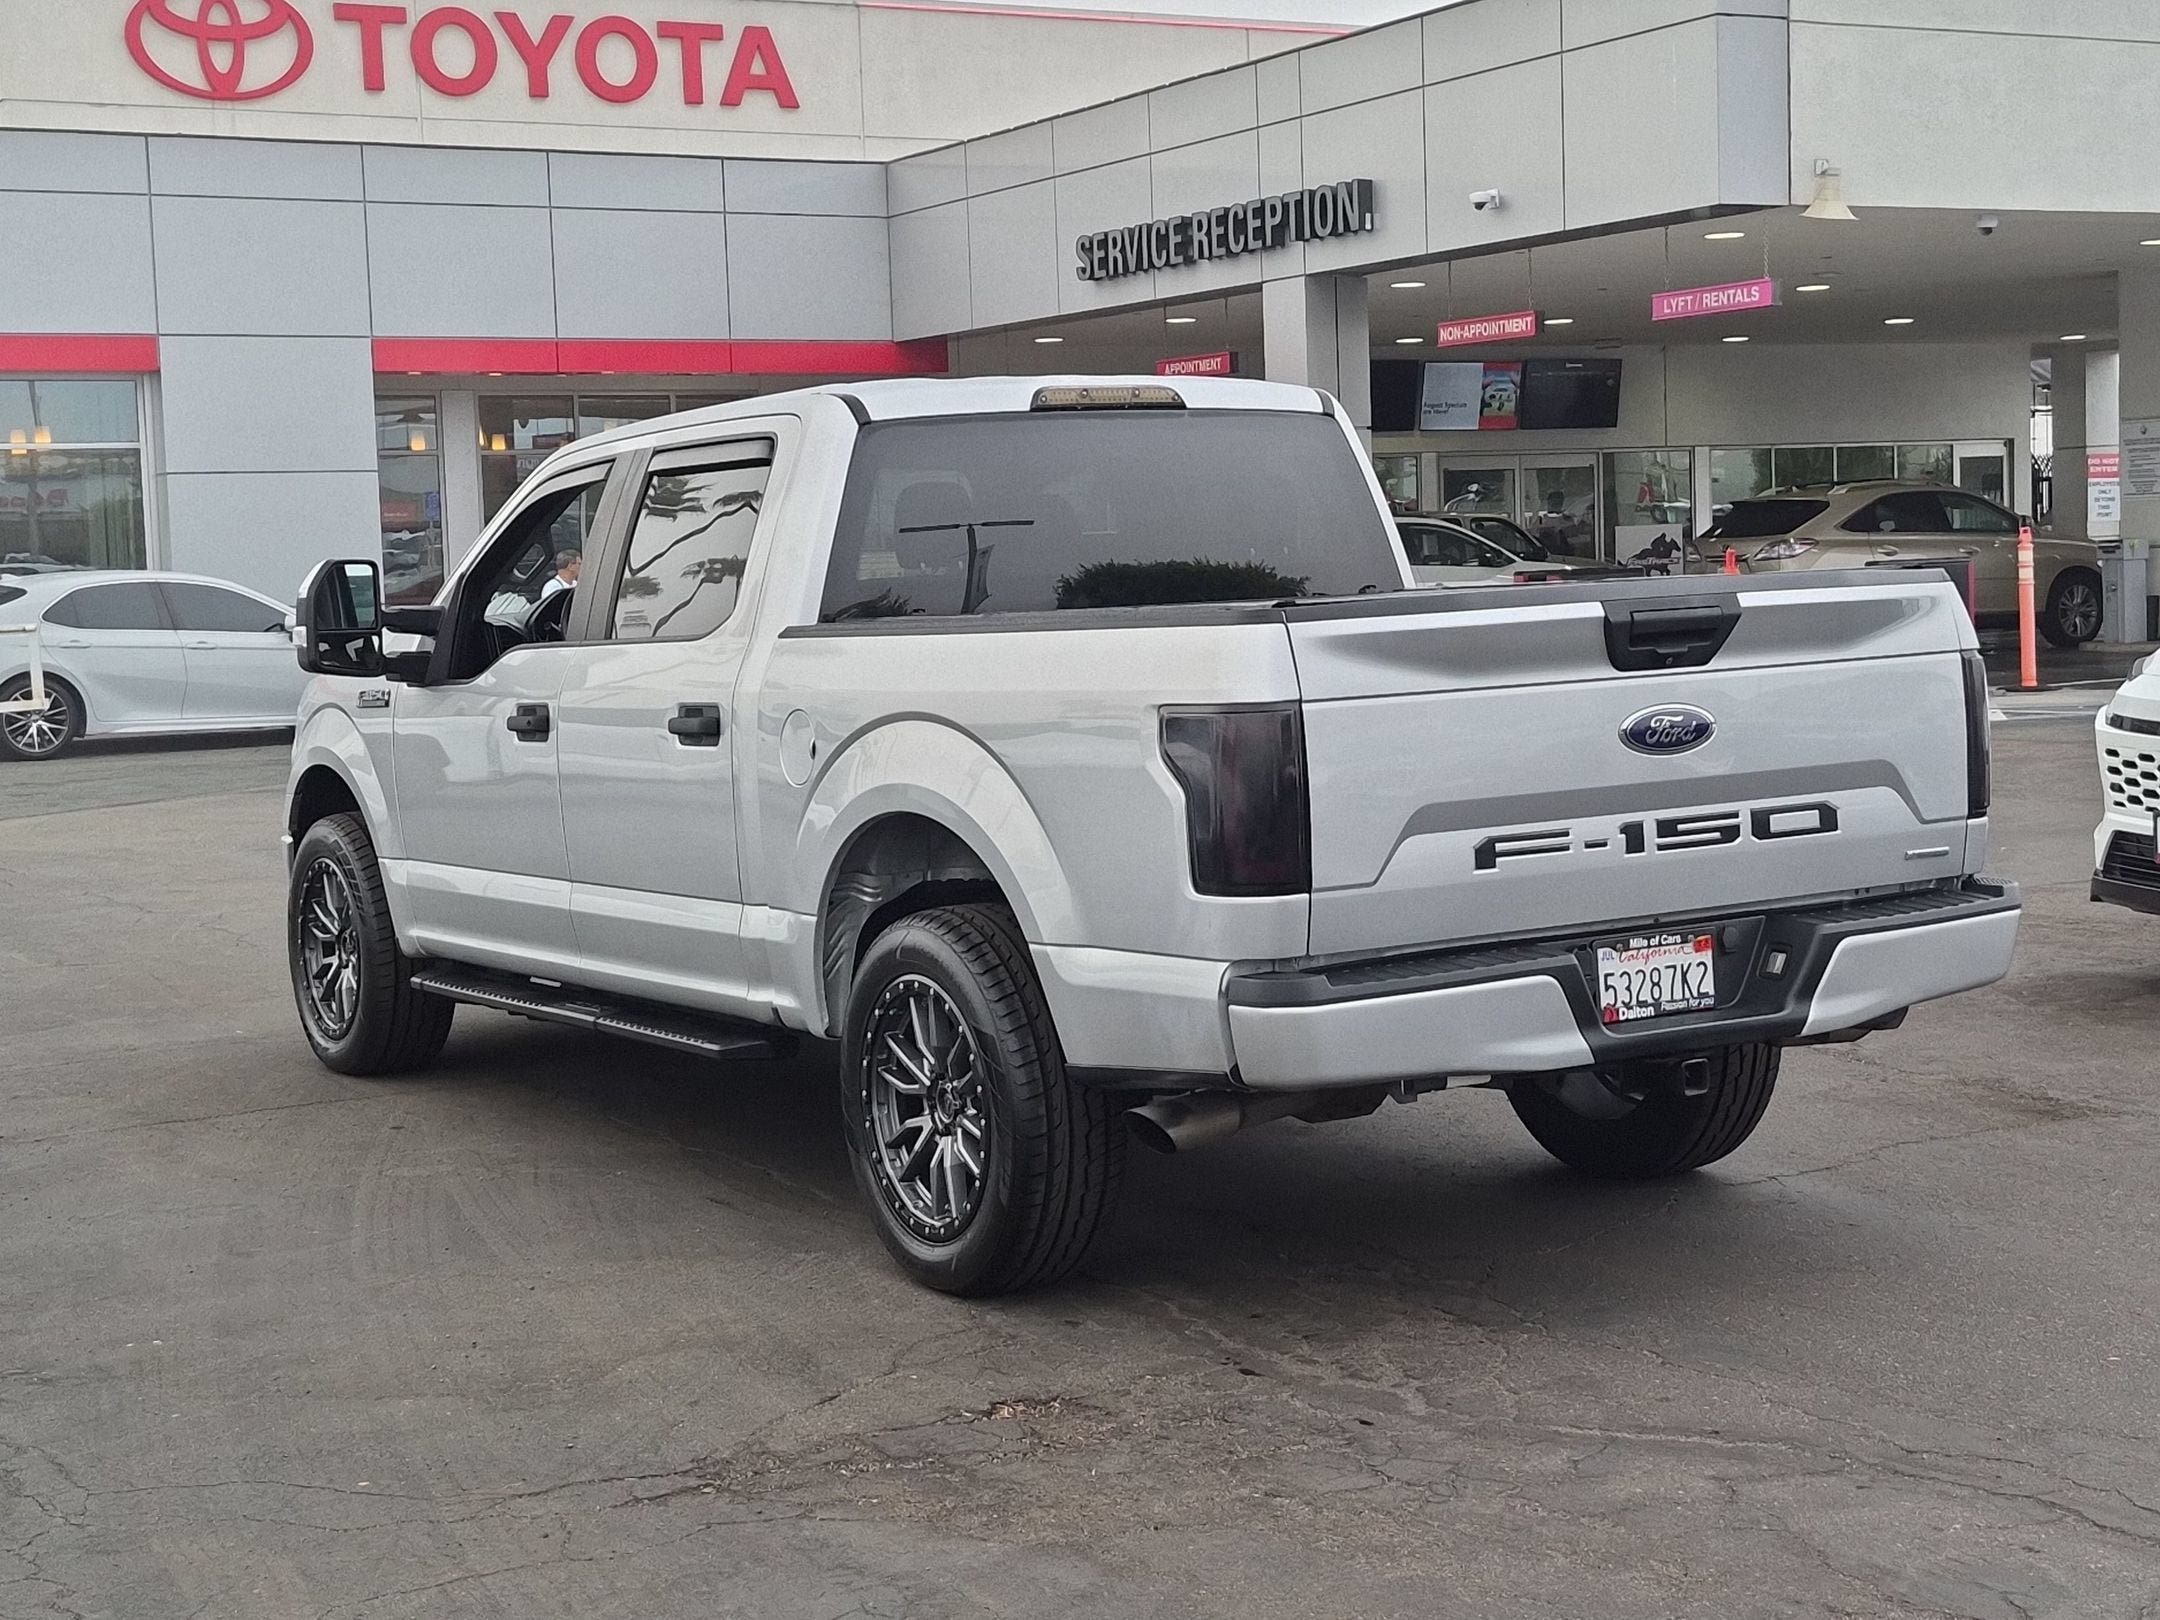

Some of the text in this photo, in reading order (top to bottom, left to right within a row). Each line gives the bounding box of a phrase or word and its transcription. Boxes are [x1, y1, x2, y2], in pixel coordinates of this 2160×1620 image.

[332, 2, 800, 109] TOYOTA
[1076, 215, 1185, 280] SERVICE
[1663, 295, 1693, 313] LYFT
[1702, 286, 1760, 308] RENTALS
[1439, 316, 1533, 342] NON-APPOINTMENT
[1164, 357, 1222, 375] APPOINTMENT
[1646, 715, 1698, 744] Ford
[1473, 800, 1841, 873] F-150
[1629, 937, 1648, 949] Mile
[1649, 935, 1660, 946] of
[1661, 934, 1682, 944] Cars
[1618, 946, 1693, 965] California
[1603, 961, 1710, 1007] 53287K2
[1618, 1006, 1655, 1021] Dalton
[1700, 997, 1715, 1008] you
